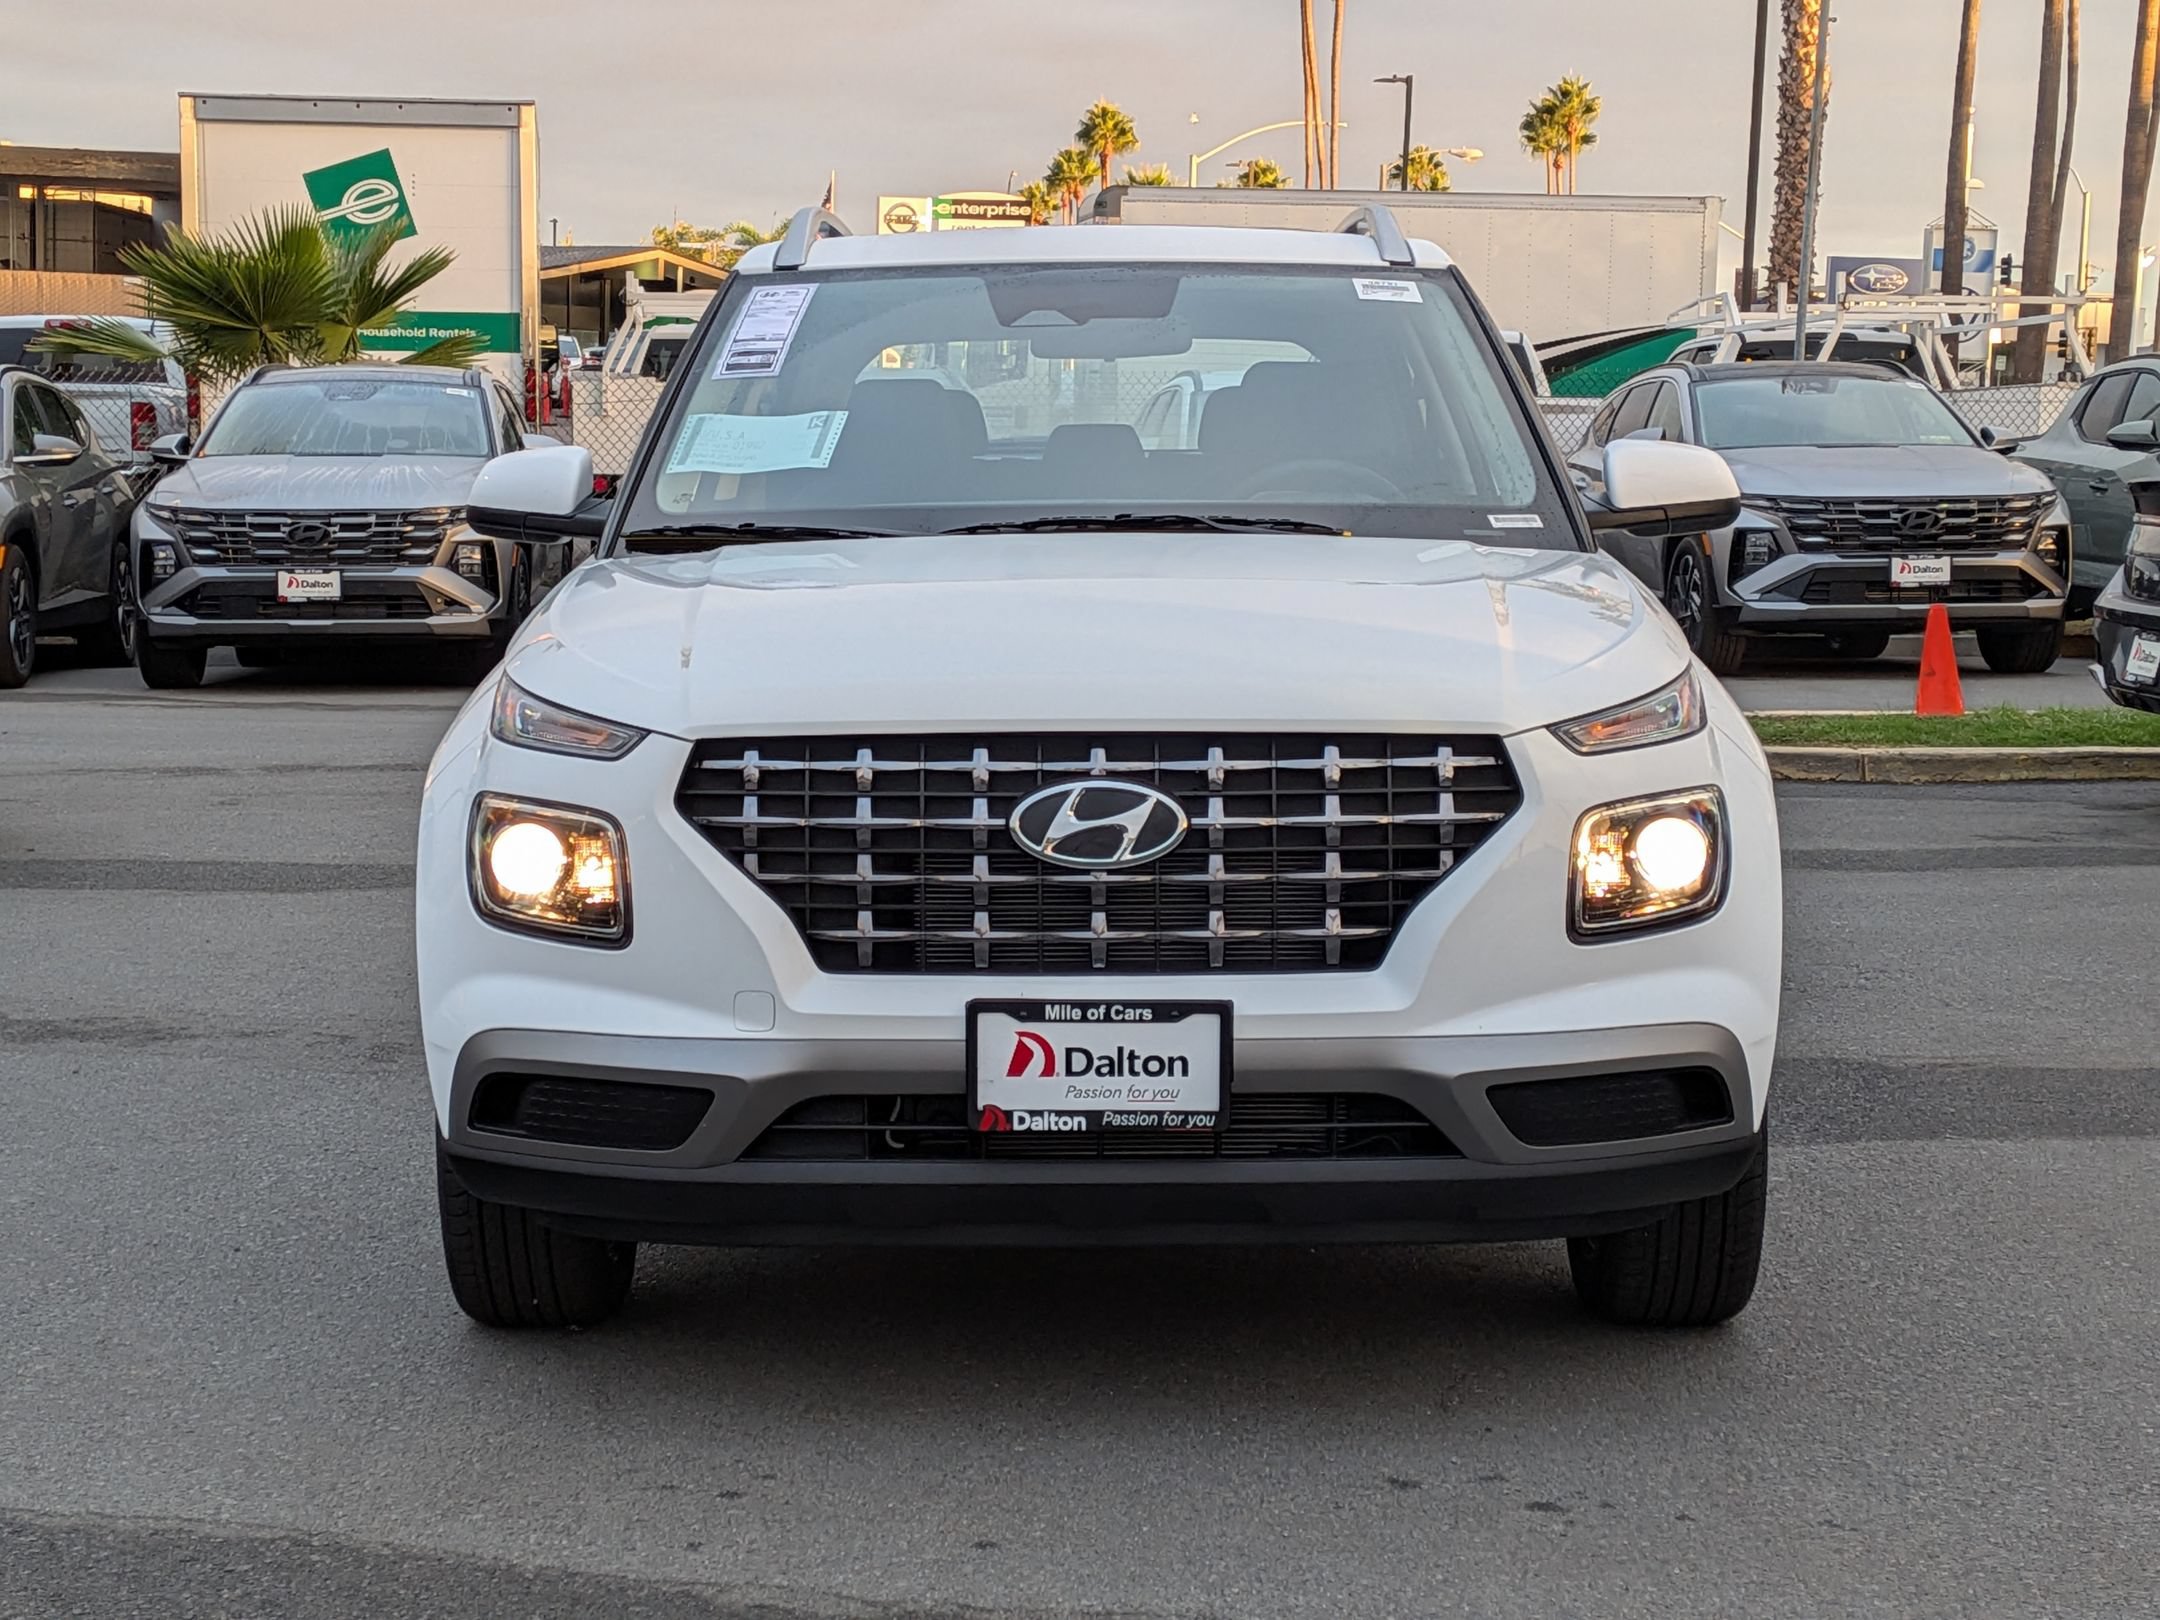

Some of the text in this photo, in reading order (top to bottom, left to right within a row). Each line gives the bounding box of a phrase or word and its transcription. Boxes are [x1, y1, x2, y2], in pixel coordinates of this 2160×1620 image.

[935, 203, 1032, 217] enterprise
[357, 327, 426, 338] Household
[1913, 565, 1943, 573] Dalton
[301, 580, 333, 588] Dalton
[1045, 1004, 1153, 1020] Mile of Cars
[1064, 1046, 1190, 1077] Dalton
[1065, 1085, 1180, 1101] Passion for you
[1013, 1111, 1086, 1131] Dalton
[1102, 1112, 1215, 1127] Passion for you
